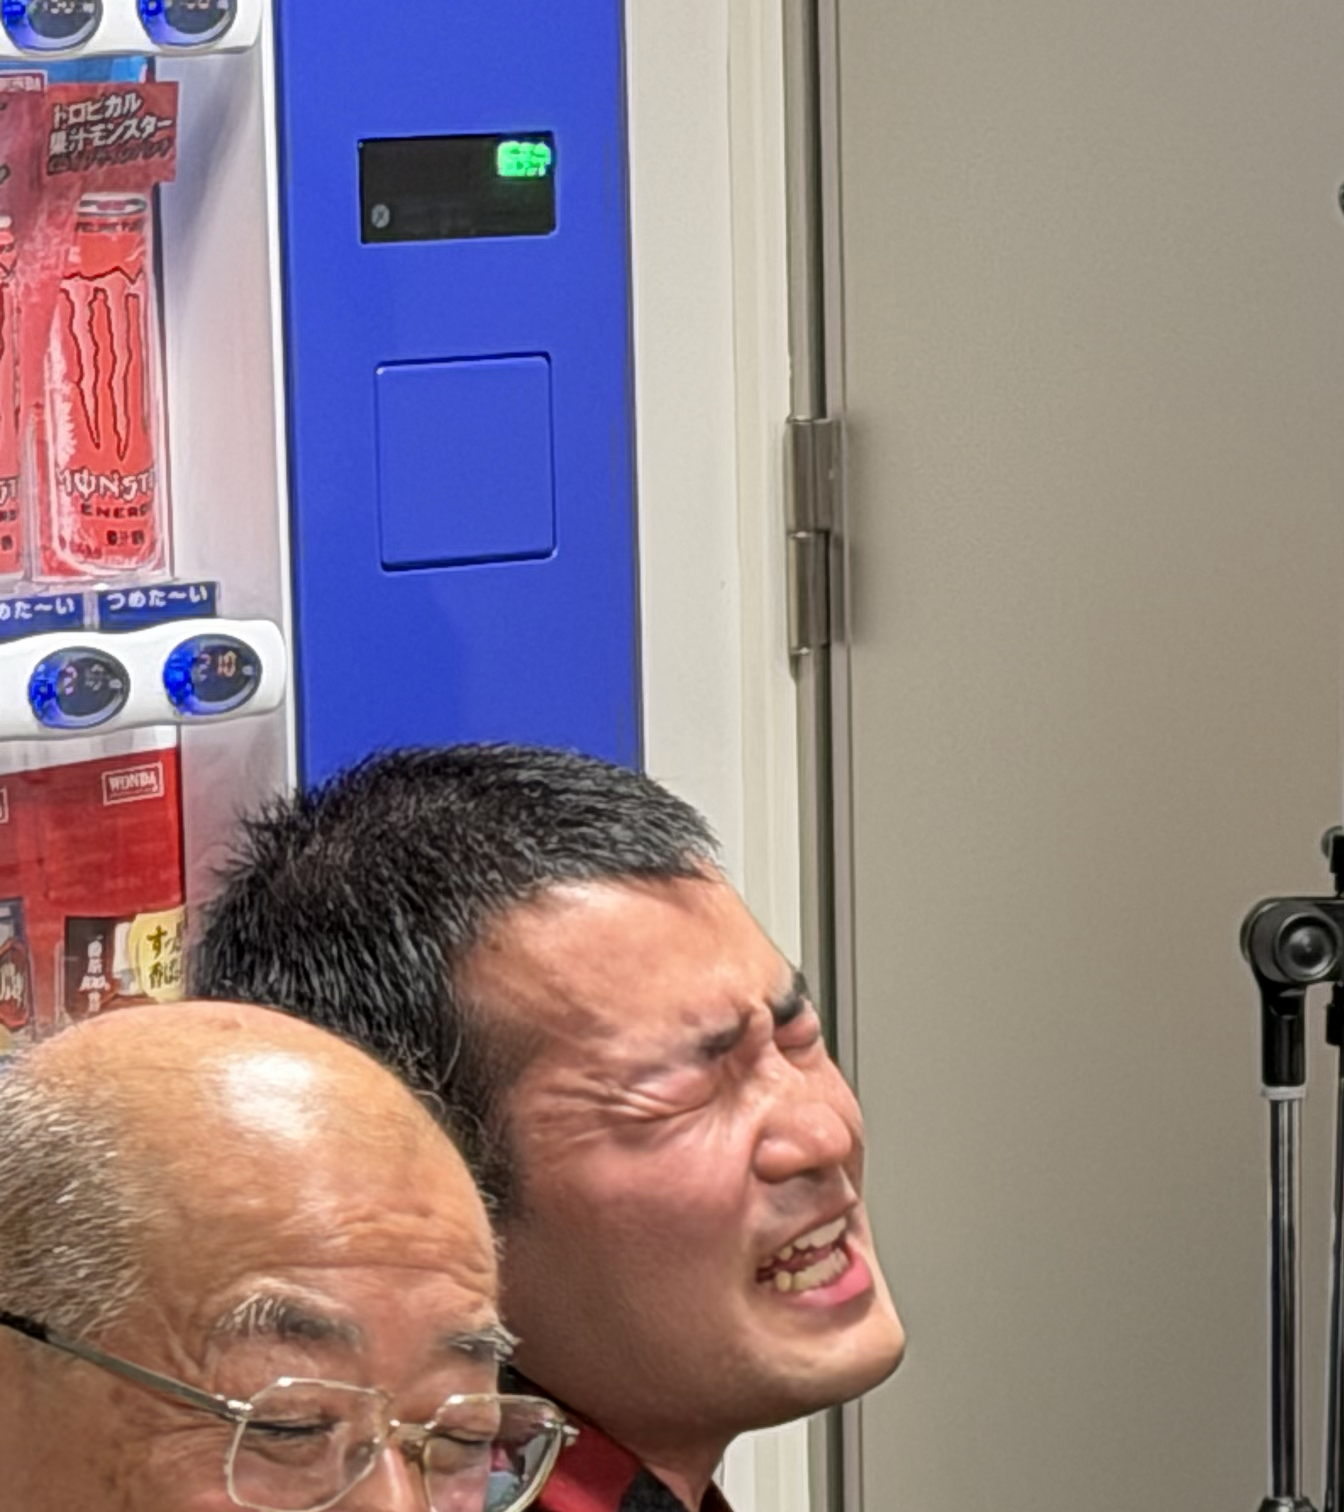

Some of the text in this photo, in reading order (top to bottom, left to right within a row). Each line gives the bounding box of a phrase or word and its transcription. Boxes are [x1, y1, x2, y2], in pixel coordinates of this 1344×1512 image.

[54, 91, 142, 129] トロピカル
[108, 771, 157, 792] WONDA
